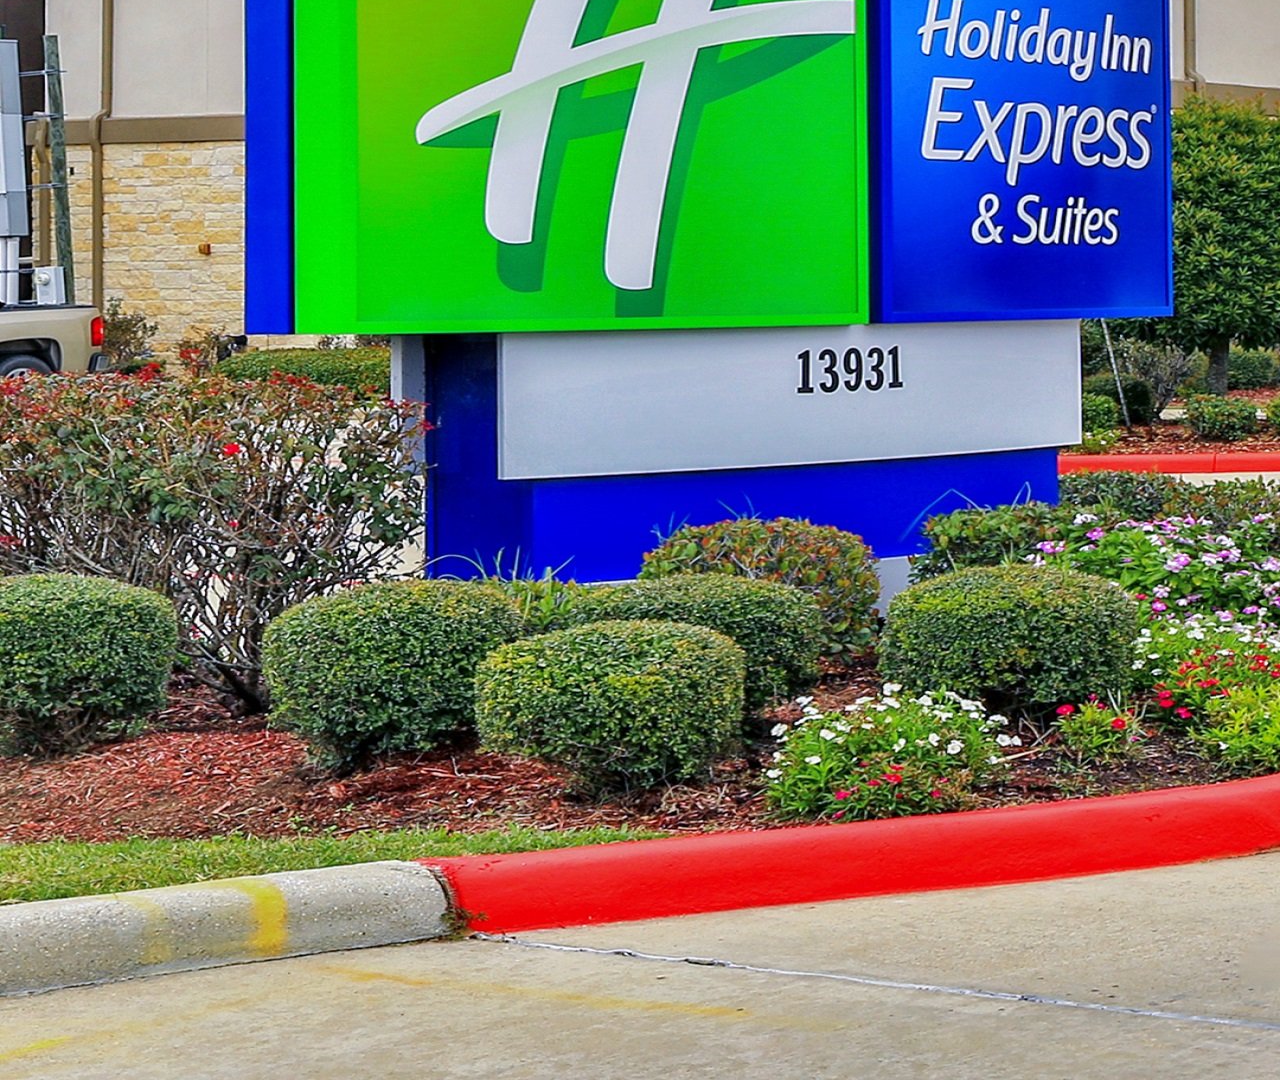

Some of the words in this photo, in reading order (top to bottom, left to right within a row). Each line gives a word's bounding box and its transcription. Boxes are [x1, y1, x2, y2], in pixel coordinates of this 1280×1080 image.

[1100, 13, 1153, 75] Inn
[920, 76, 1153, 187] Express
[971, 192, 1004, 244] &
[1012, 194, 1119, 245] Suites
[796, 345, 904, 394] 13931
